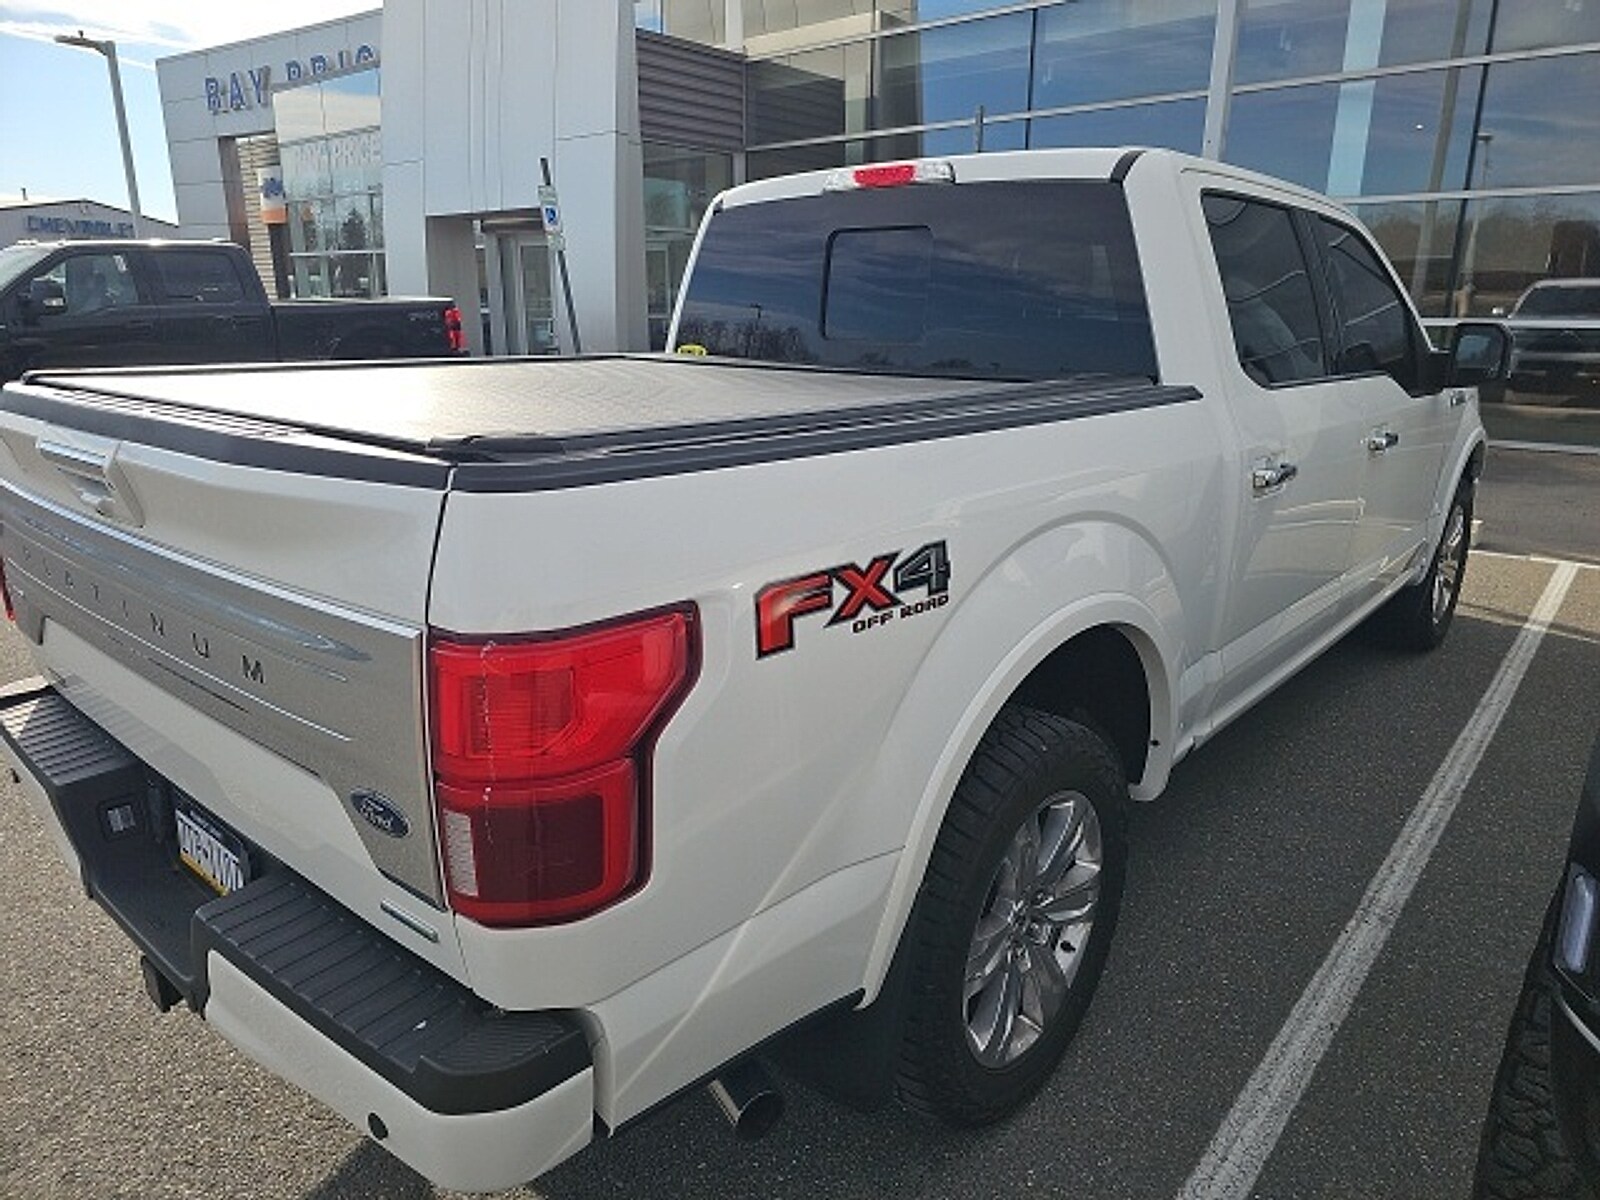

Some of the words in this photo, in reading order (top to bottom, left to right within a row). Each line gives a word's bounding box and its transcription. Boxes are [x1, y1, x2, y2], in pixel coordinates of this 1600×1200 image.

[754, 540, 951, 660] FX4
[852, 611, 894, 634] OFF
[900, 594, 950, 619] ROAD
